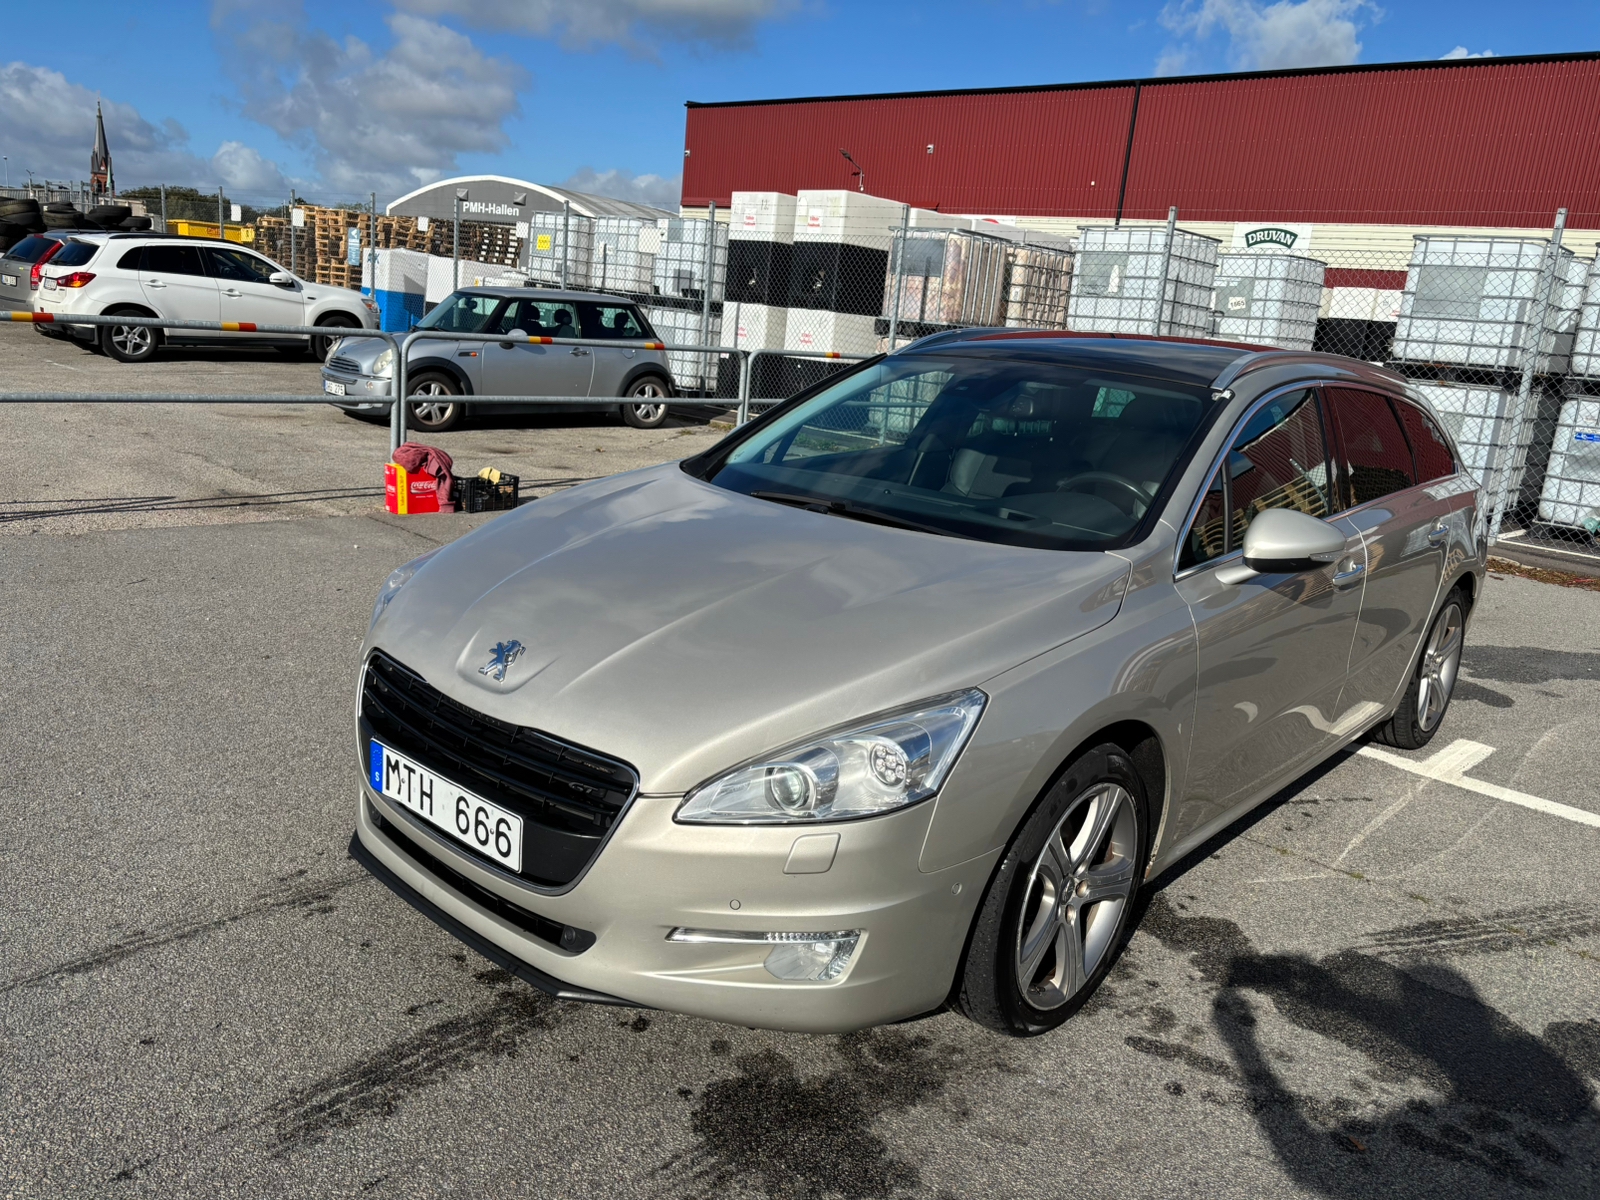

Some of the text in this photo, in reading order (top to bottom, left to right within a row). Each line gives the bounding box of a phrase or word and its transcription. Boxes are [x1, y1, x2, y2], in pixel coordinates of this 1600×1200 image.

[463, 202, 519, 216] PMH-Hallen
[1247, 230, 1295, 245] DRUVAN
[568, 781, 599, 794] GT
[385, 754, 512, 858] MTH 666
